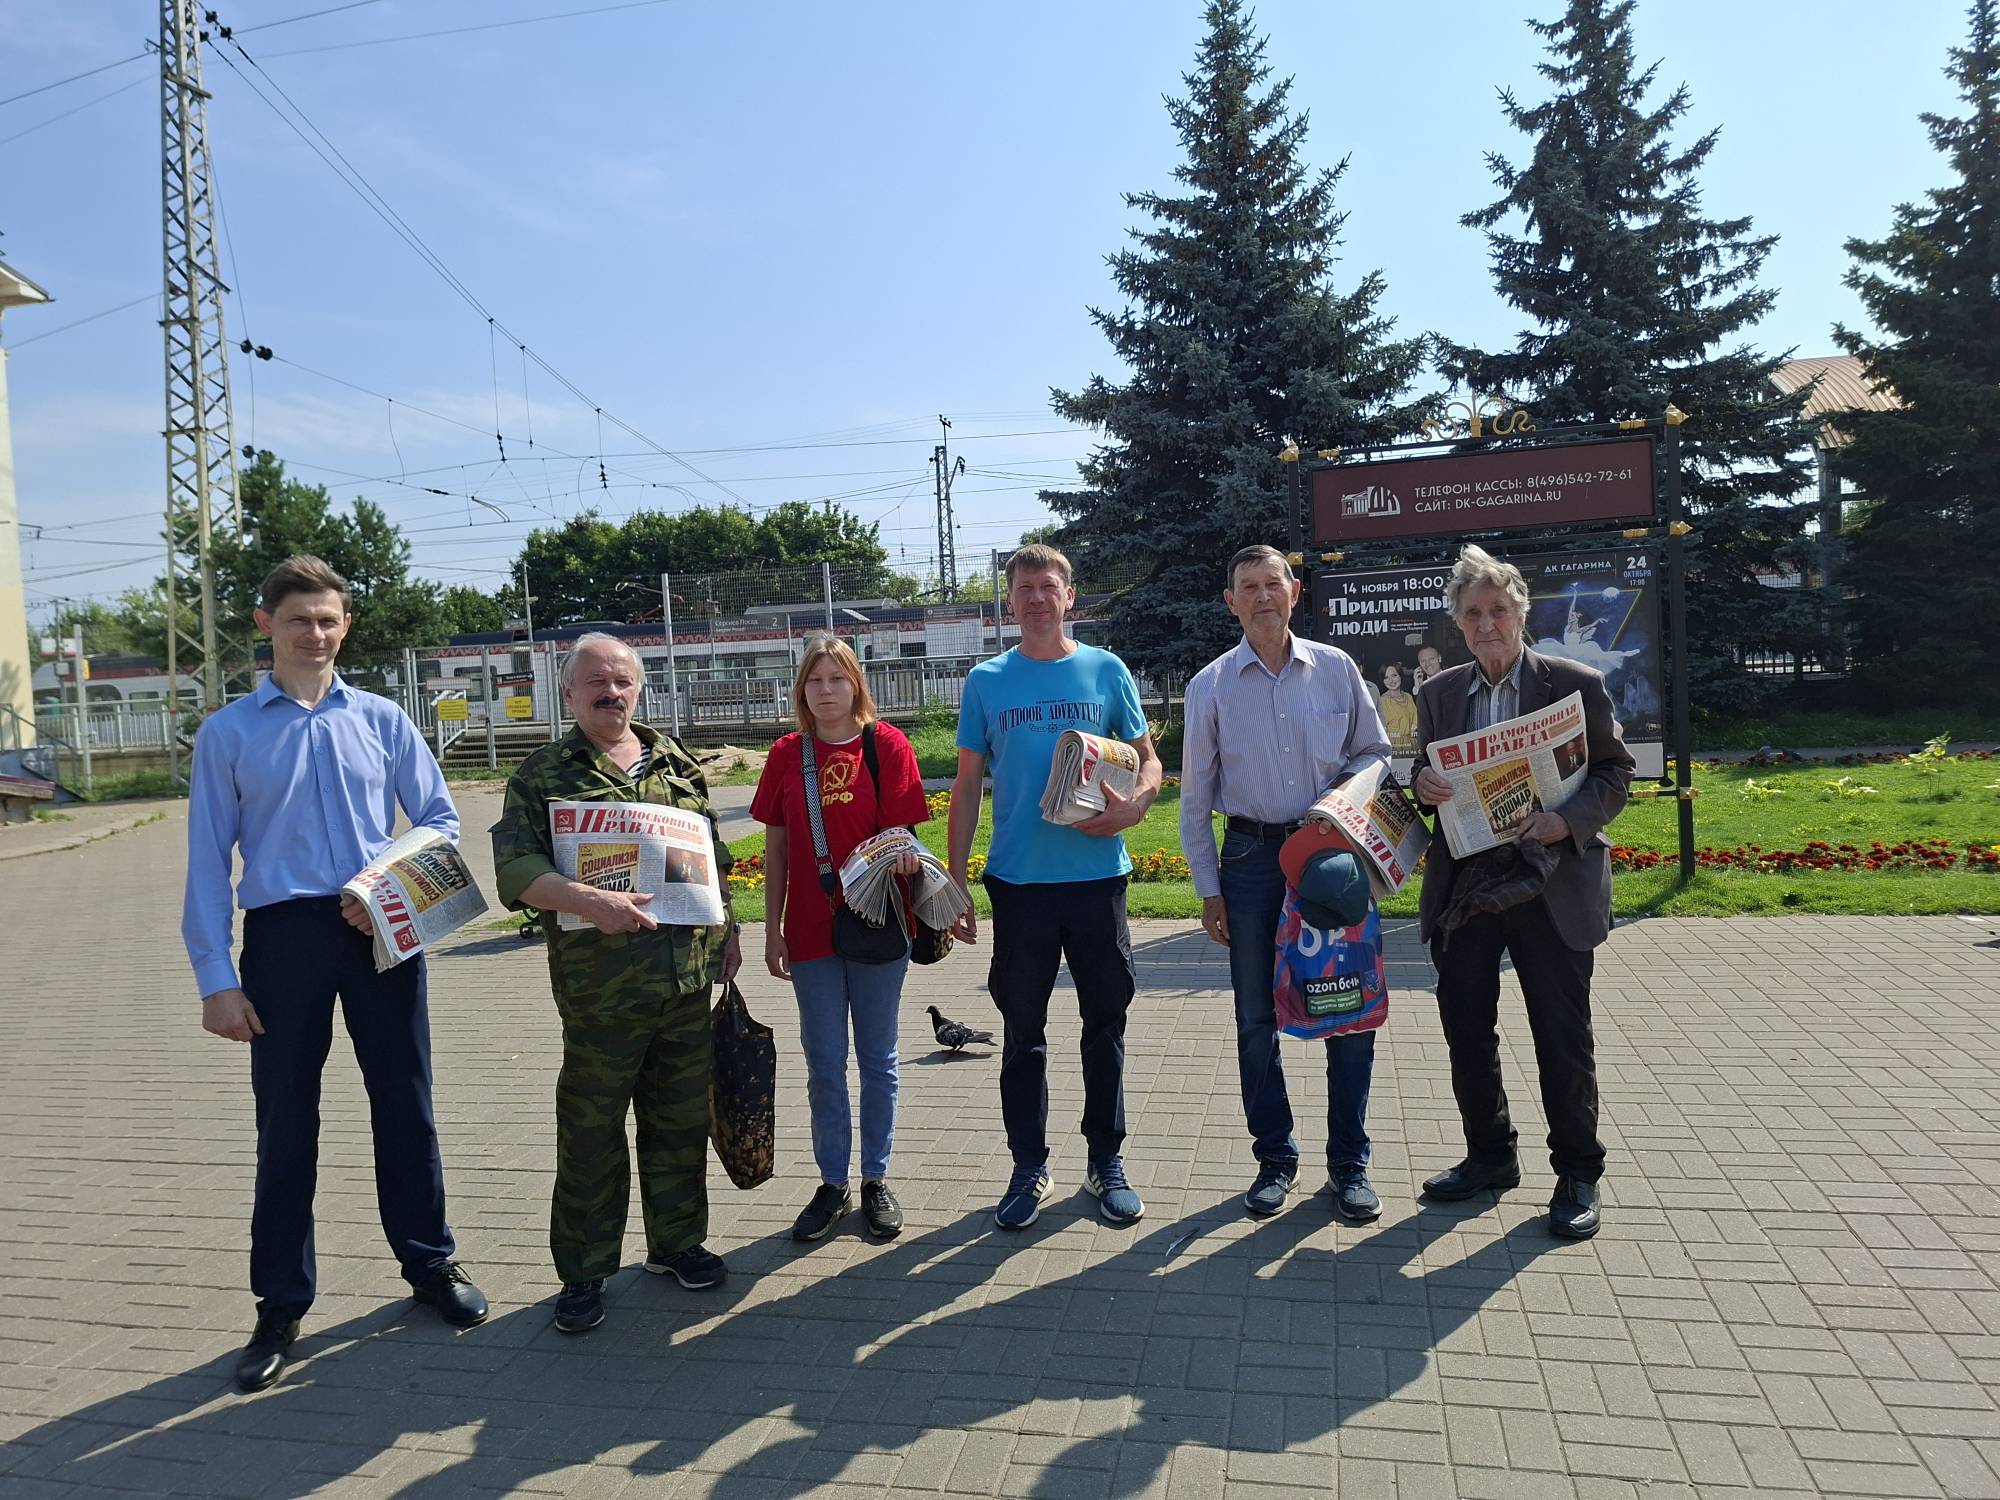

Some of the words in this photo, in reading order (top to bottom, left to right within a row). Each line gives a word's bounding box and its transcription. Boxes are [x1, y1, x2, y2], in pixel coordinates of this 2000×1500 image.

[1414, 483, 1470, 498] ТЕЛЕФОН
[1475, 478, 1522, 493] КАССЫ:
[1527, 469, 1632, 489] 8(496)542-72-61
[1415, 499, 1451, 513] САЙТ:
[1455, 490, 1561, 509] DK-GAGARINA.RU
[1561, 561, 1612, 571] ГАГАРИНА
[1626, 556, 1647, 570] 24
[1624, 570, 1652, 578] ОКТЯБРЯ
[1342, 582, 1357, 594] 14
[1361, 582, 1399, 594] НОЯБРЯ
[1402, 576, 1444, 590] 18:00
[1328, 596, 1448, 616] ПРИЛИЧНЫ
[772, 616, 778, 628] 2
[1329, 620, 1388, 636] ЛЮДИ
[1000, 706, 1042, 734] OUTDOOR
[1048, 702, 1104, 726] ADVENTURE
[1482, 762, 1530, 800] СОЦИАЛИЗМ
[822, 791, 854, 806] ПРФ
[1492, 788, 1532, 824] КОШМАР
[418, 852, 456, 888] КОШМАР
[582, 850, 638, 876] СОЦИАЛИЗМ
